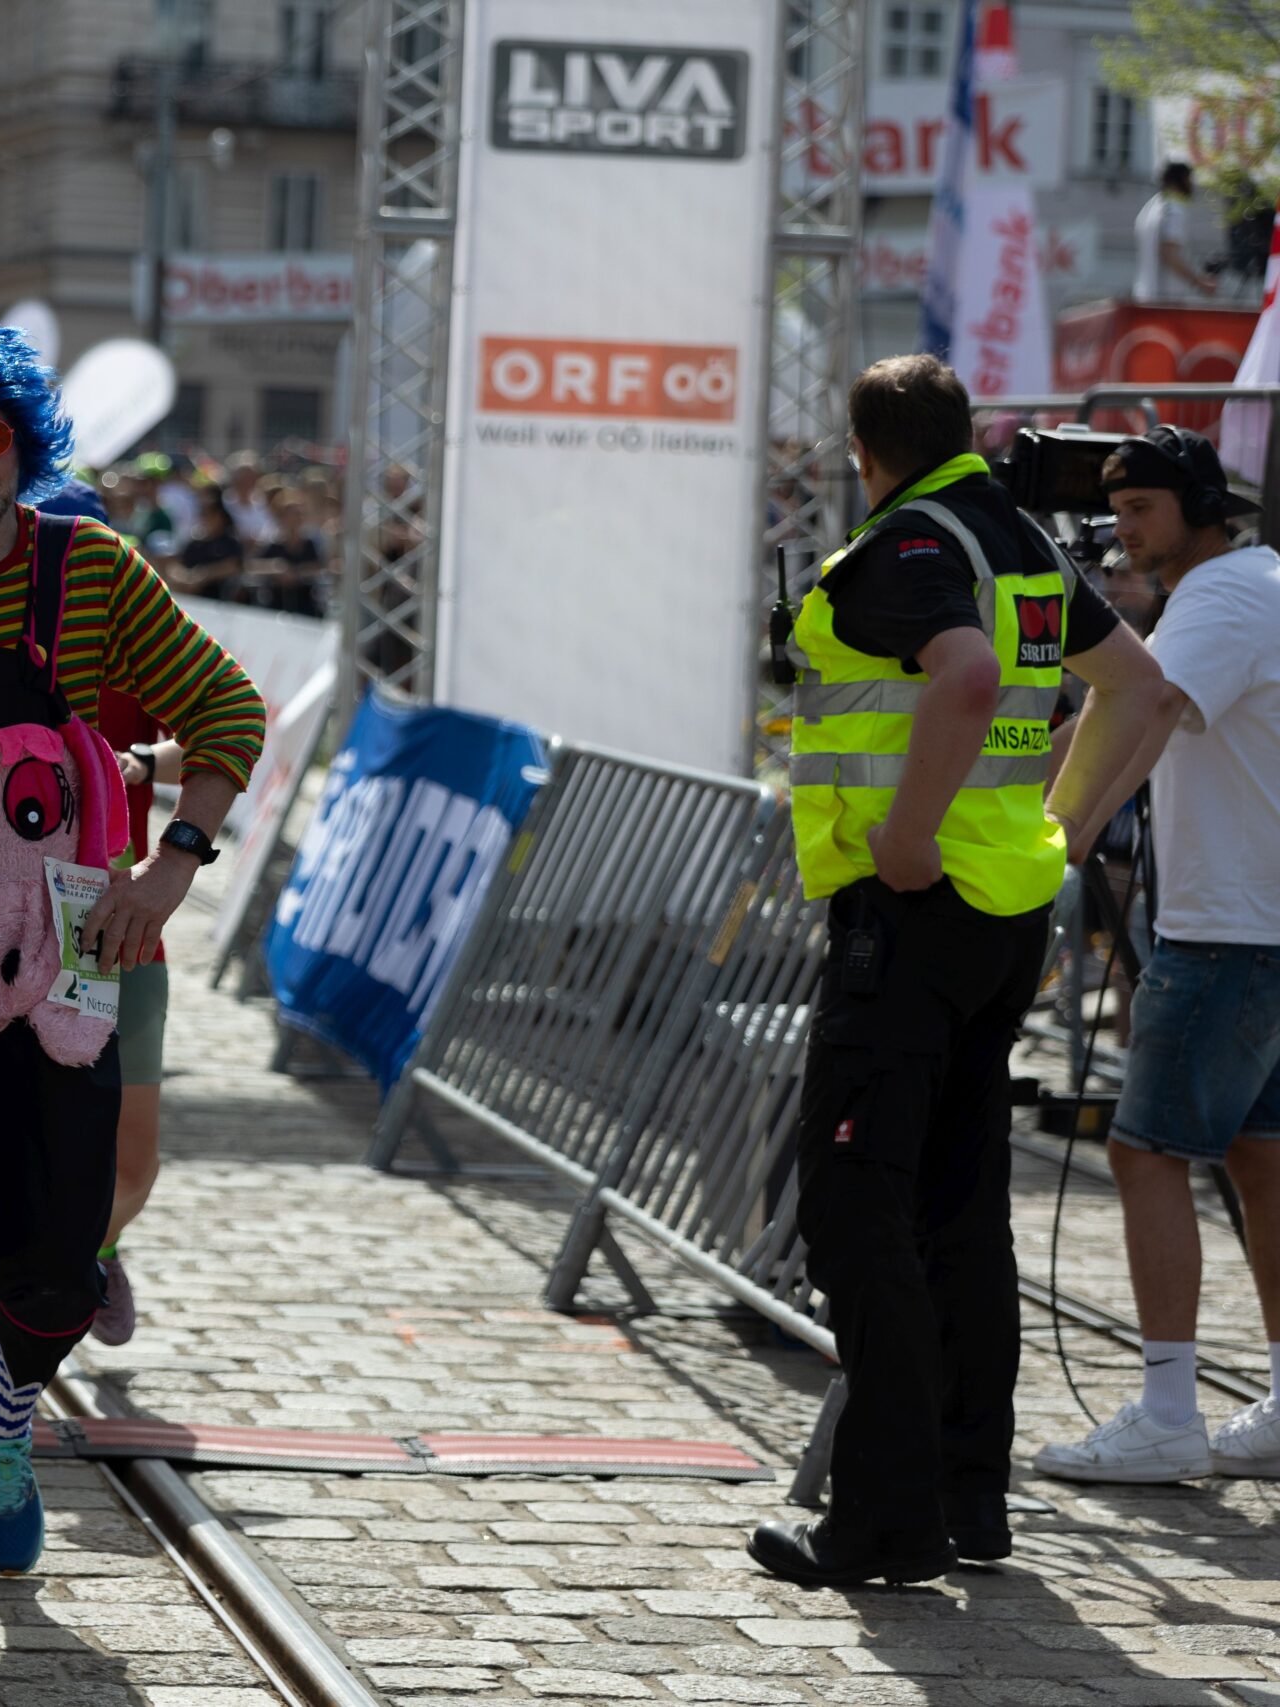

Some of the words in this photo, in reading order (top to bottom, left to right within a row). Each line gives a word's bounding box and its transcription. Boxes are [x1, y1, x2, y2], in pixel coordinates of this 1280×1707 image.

[508, 50, 734, 114] LIVA
[508, 107, 736, 150] SPORT
[970, 208, 1032, 396] erbank
[490, 349, 650, 405] ORF
[476, 423, 535, 447] Weil
[546, 427, 591, 448] wir
